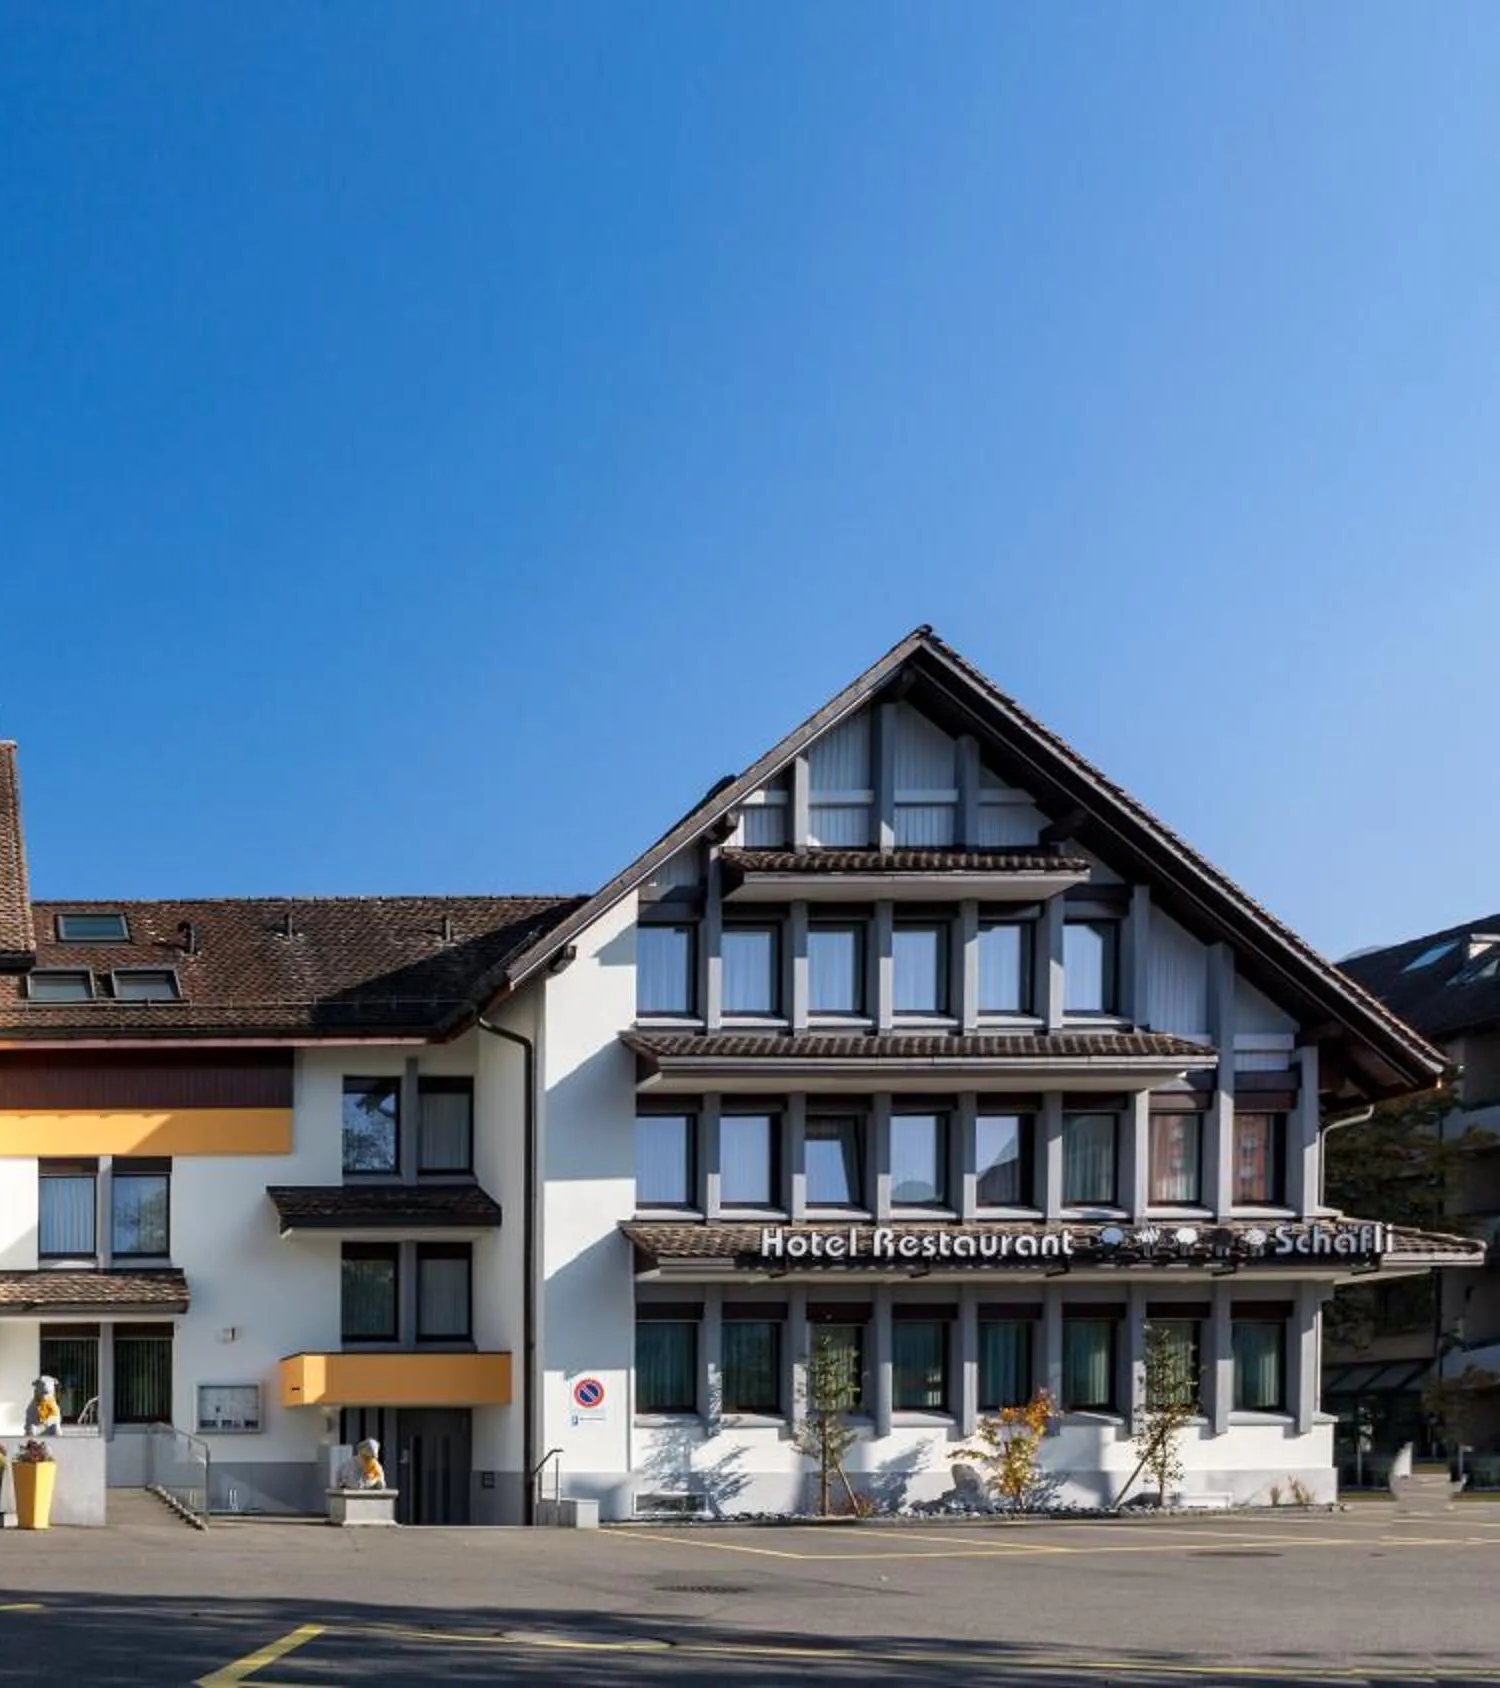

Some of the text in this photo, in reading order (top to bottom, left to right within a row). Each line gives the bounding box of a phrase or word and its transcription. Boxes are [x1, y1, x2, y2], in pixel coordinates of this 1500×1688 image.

[760, 1223, 1393, 1257] Hotel Restaurant Schäfli
